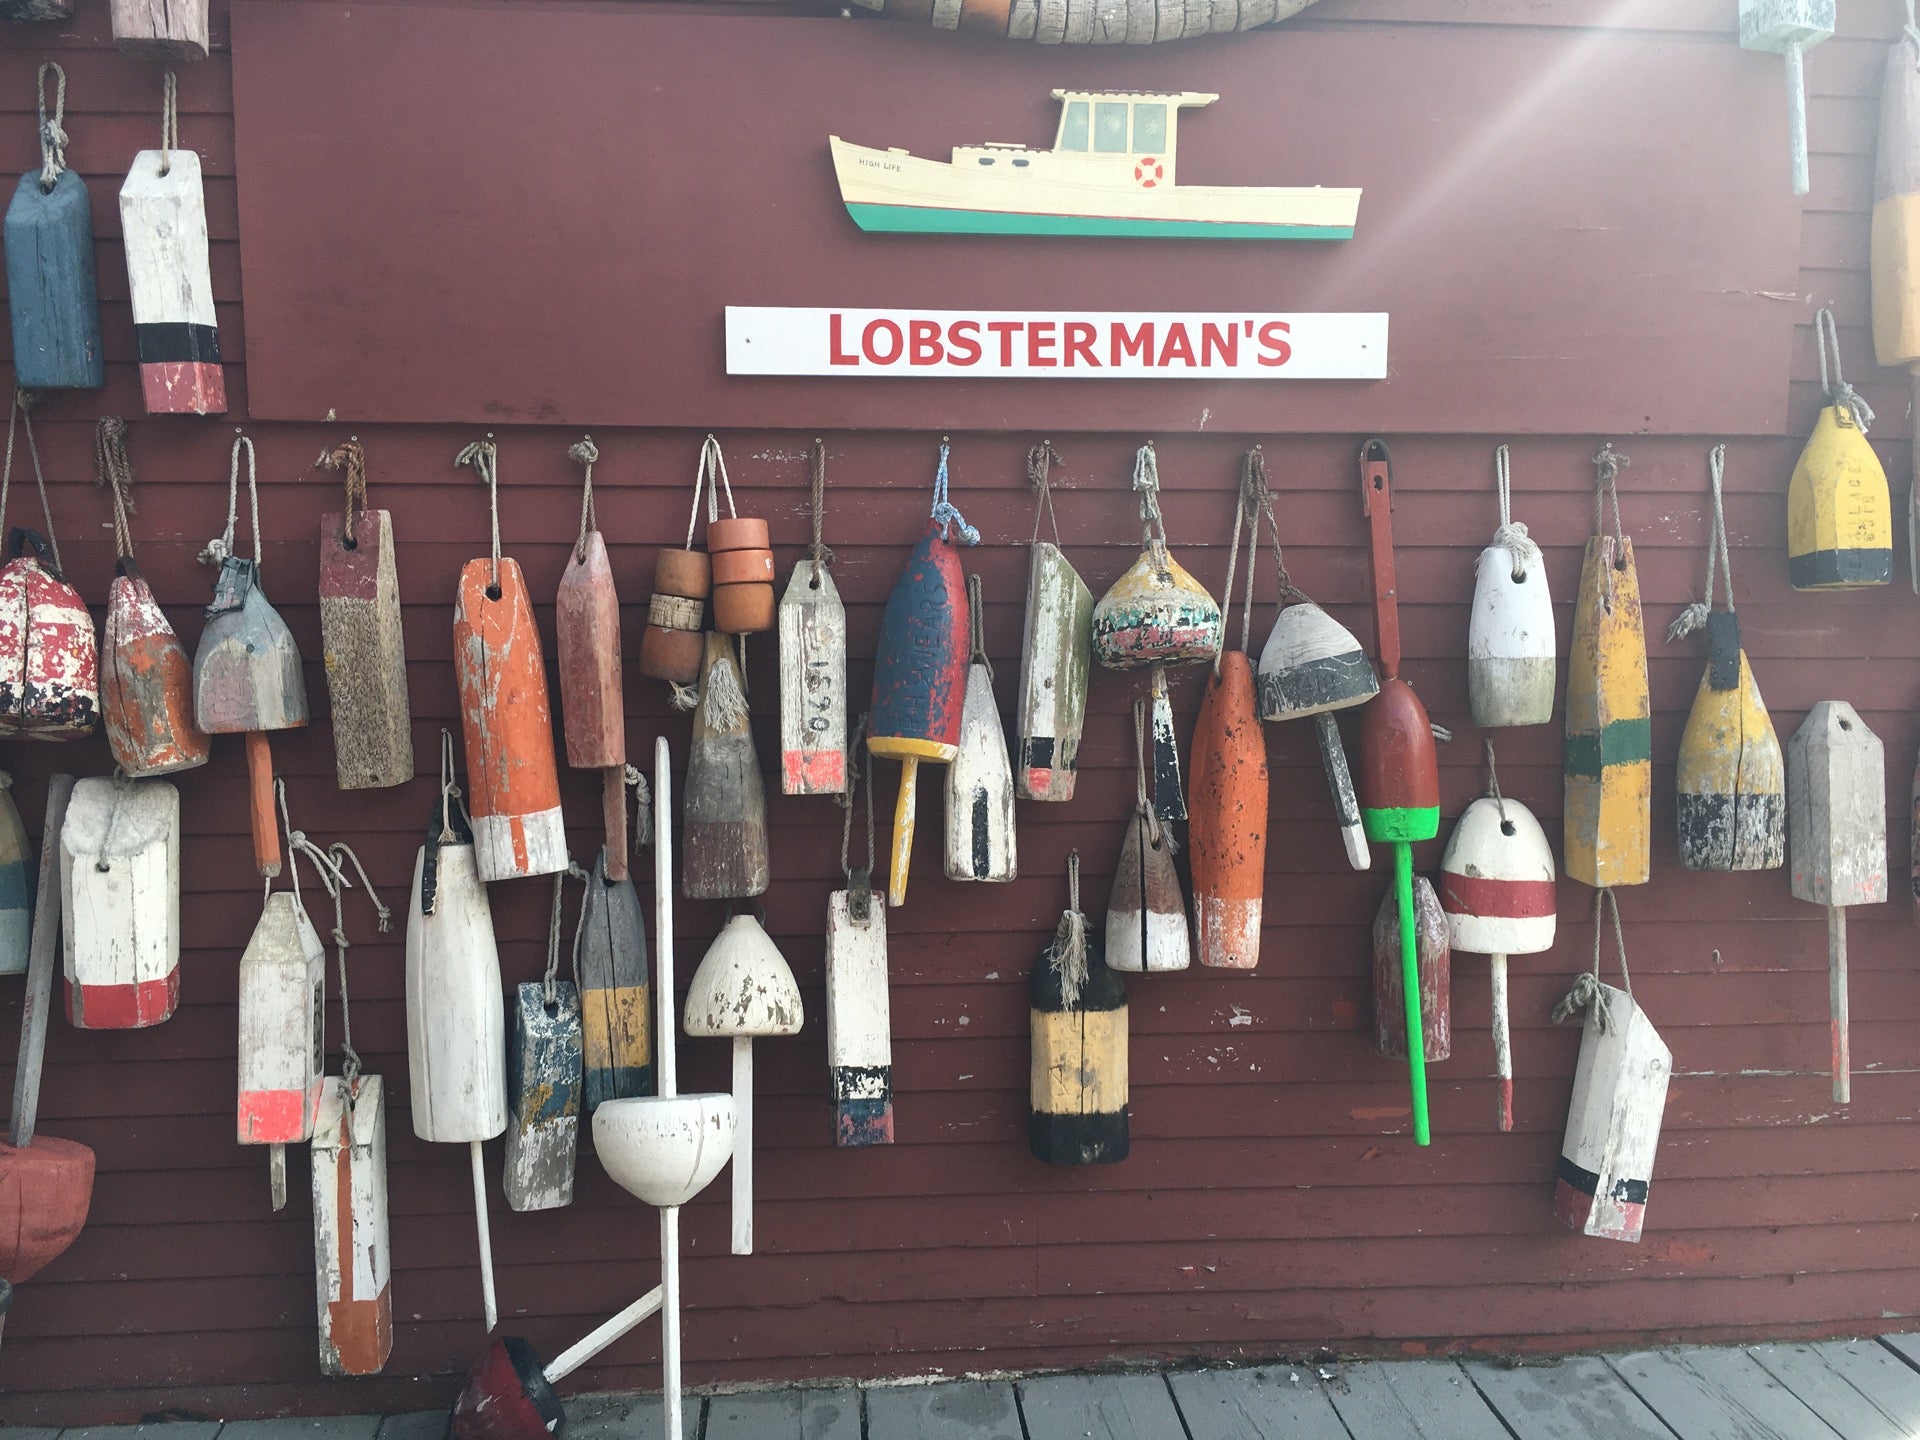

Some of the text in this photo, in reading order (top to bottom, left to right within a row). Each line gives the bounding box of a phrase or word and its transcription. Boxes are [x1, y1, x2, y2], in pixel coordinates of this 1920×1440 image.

[859, 158, 902, 172] HIGH LIFE
[829, 313, 1292, 369] LOBSTERMAN'S
